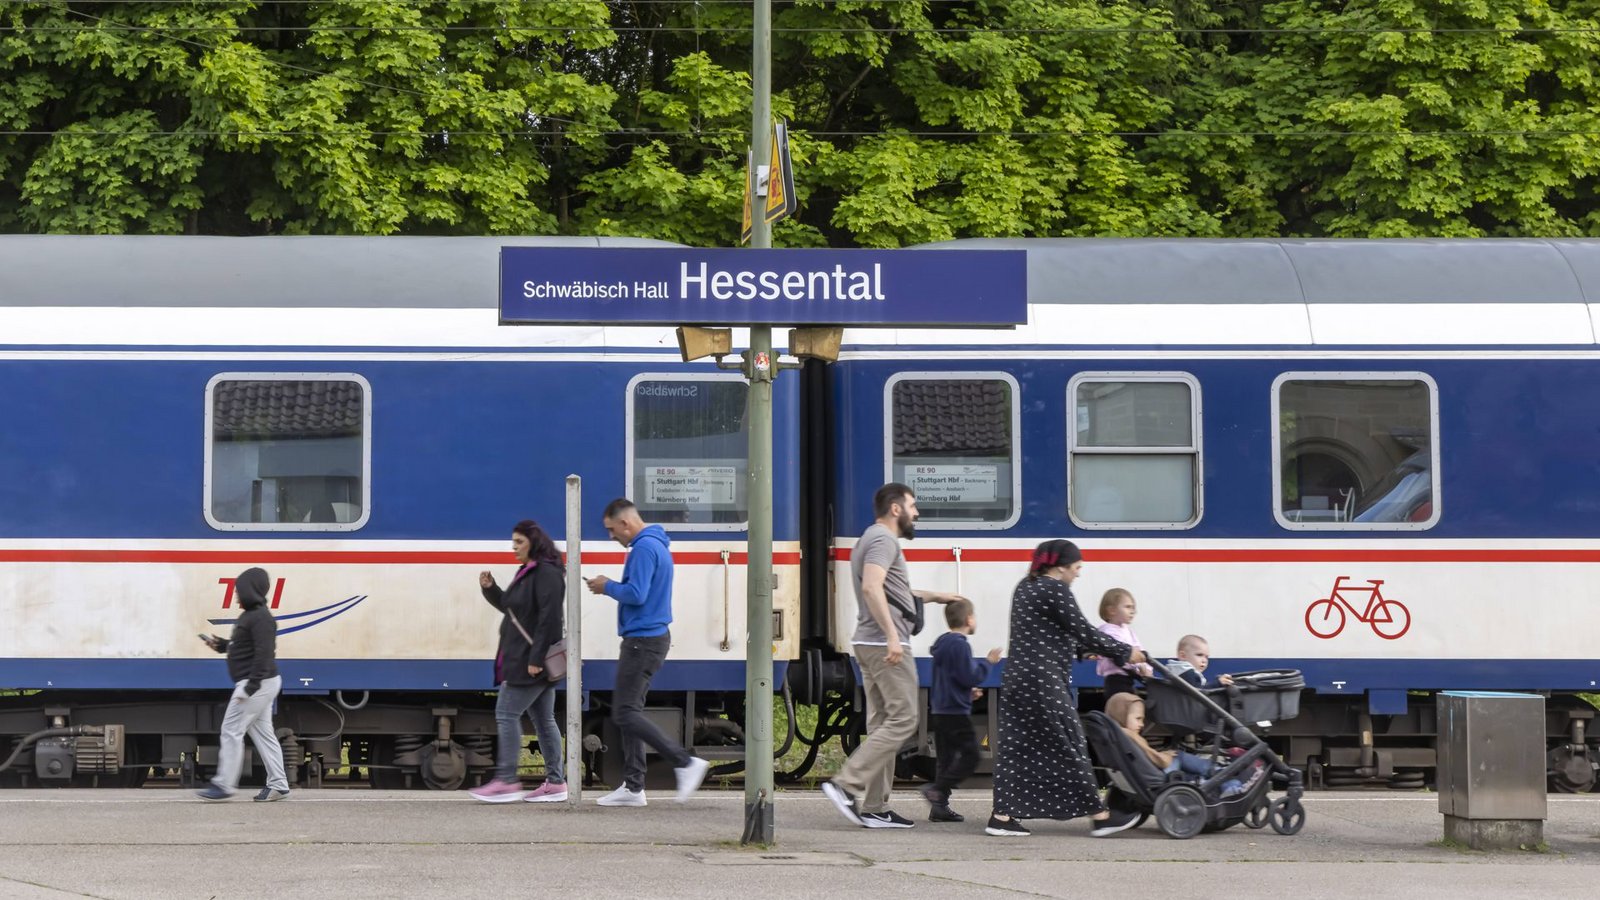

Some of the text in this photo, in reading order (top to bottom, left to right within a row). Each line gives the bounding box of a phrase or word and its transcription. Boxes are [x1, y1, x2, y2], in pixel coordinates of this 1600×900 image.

[523, 261, 886, 301] Schwäbisch Hall Hessental
[657, 478, 686, 486] Stuttgart
[917, 476, 947, 484] Stuttgart
[218, 578, 286, 609] TI
